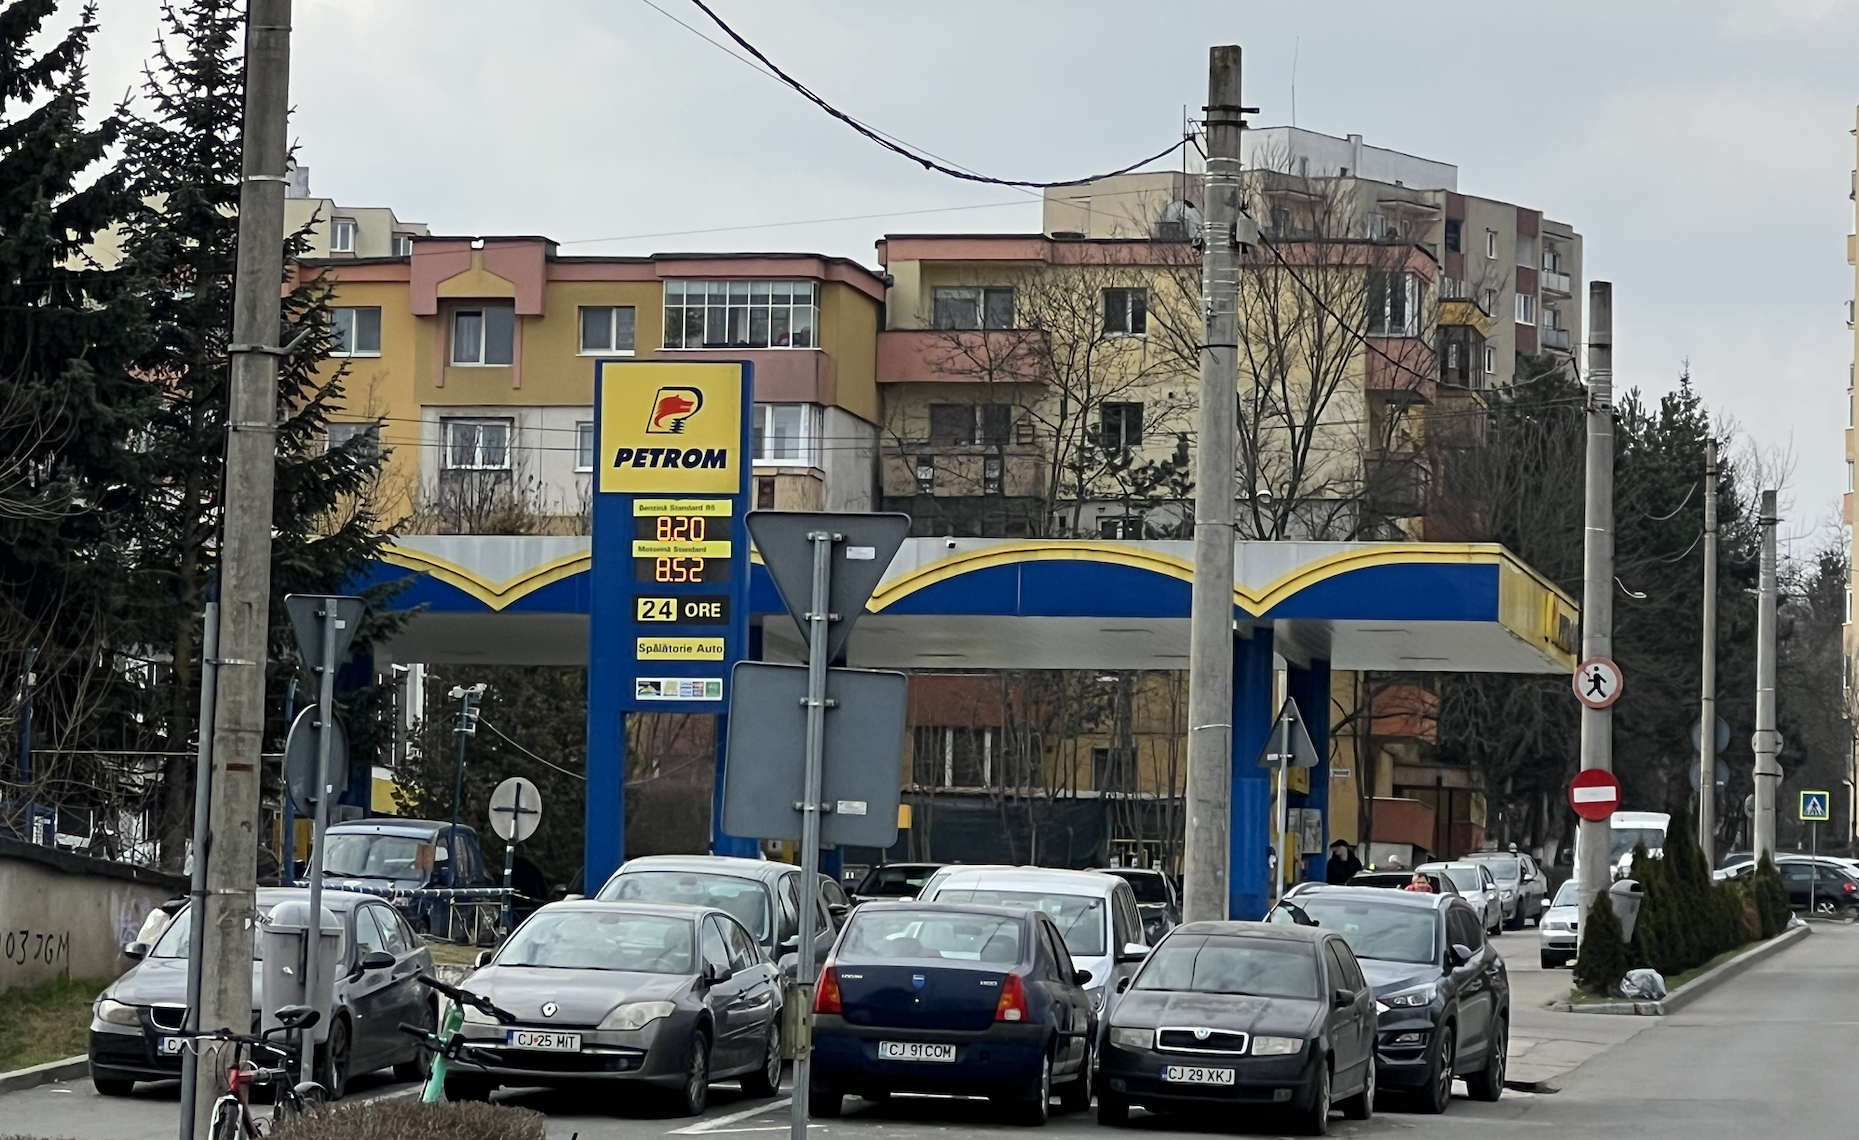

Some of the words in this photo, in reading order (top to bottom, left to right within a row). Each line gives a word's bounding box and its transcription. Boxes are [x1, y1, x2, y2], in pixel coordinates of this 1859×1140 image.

[613, 448, 727, 469] PETROM
[642, 600, 673, 619] 24
[684, 602, 721, 618] ORE
[638, 643, 693, 654] Spălătorie
[696, 644, 723, 653] Auto
[518, 1033, 533, 1046] CJ
[537, 1035, 552, 1047] 25
[889, 1043, 905, 1056] CJ
[1168, 1067, 1184, 1080] CJ
[1188, 1069, 1203, 1081] 29
[1207, 1069, 1232, 1083] XKJ
